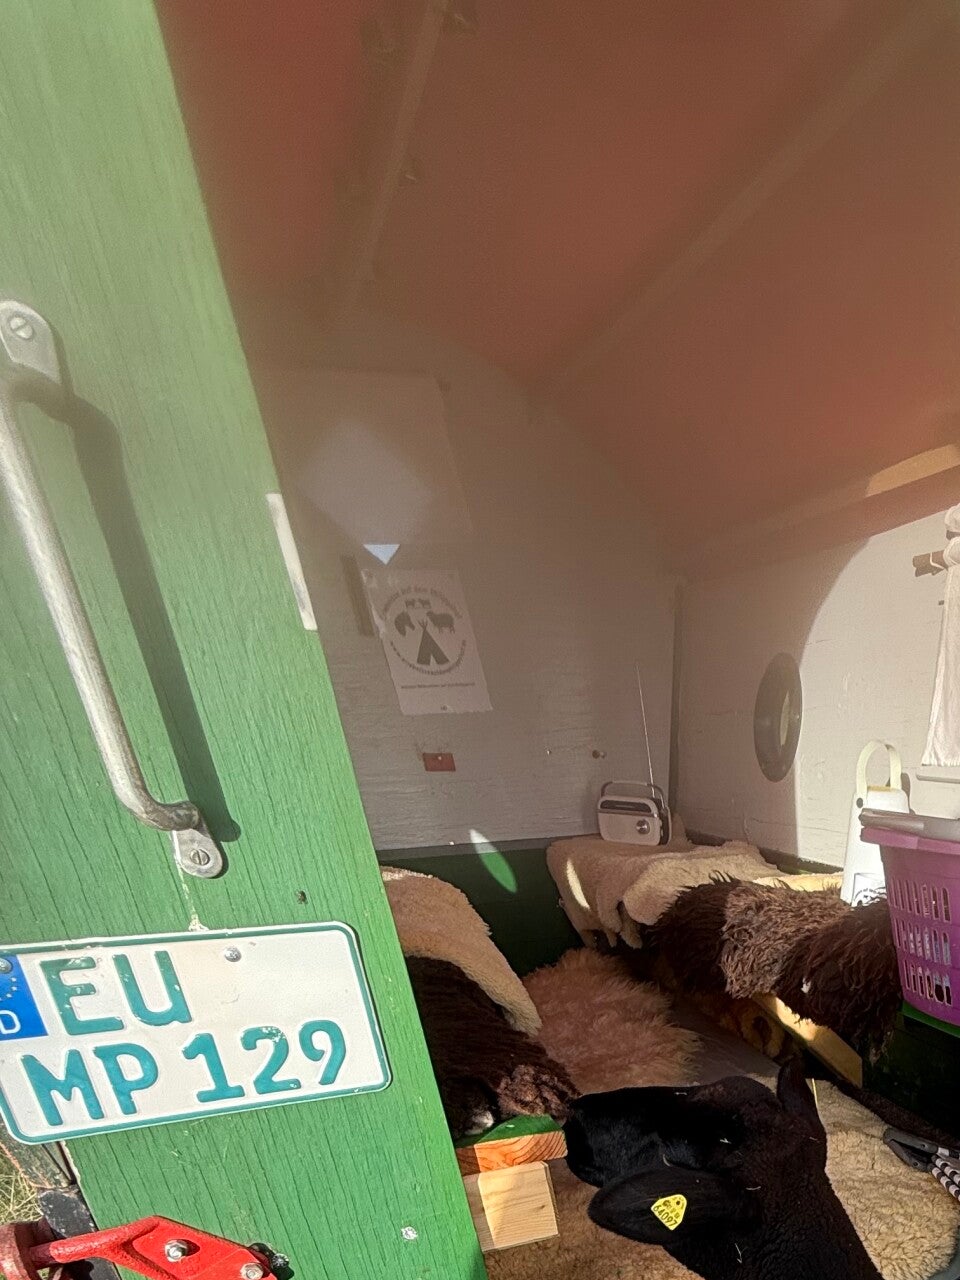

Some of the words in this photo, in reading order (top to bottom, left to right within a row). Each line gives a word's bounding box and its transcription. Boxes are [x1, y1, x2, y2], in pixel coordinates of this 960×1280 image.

[0, 1009, 22, 1035] D
[39, 950, 192, 1036] EU
[21, 1043, 159, 1127] MP
[182, 1020, 346, 1103] 129
